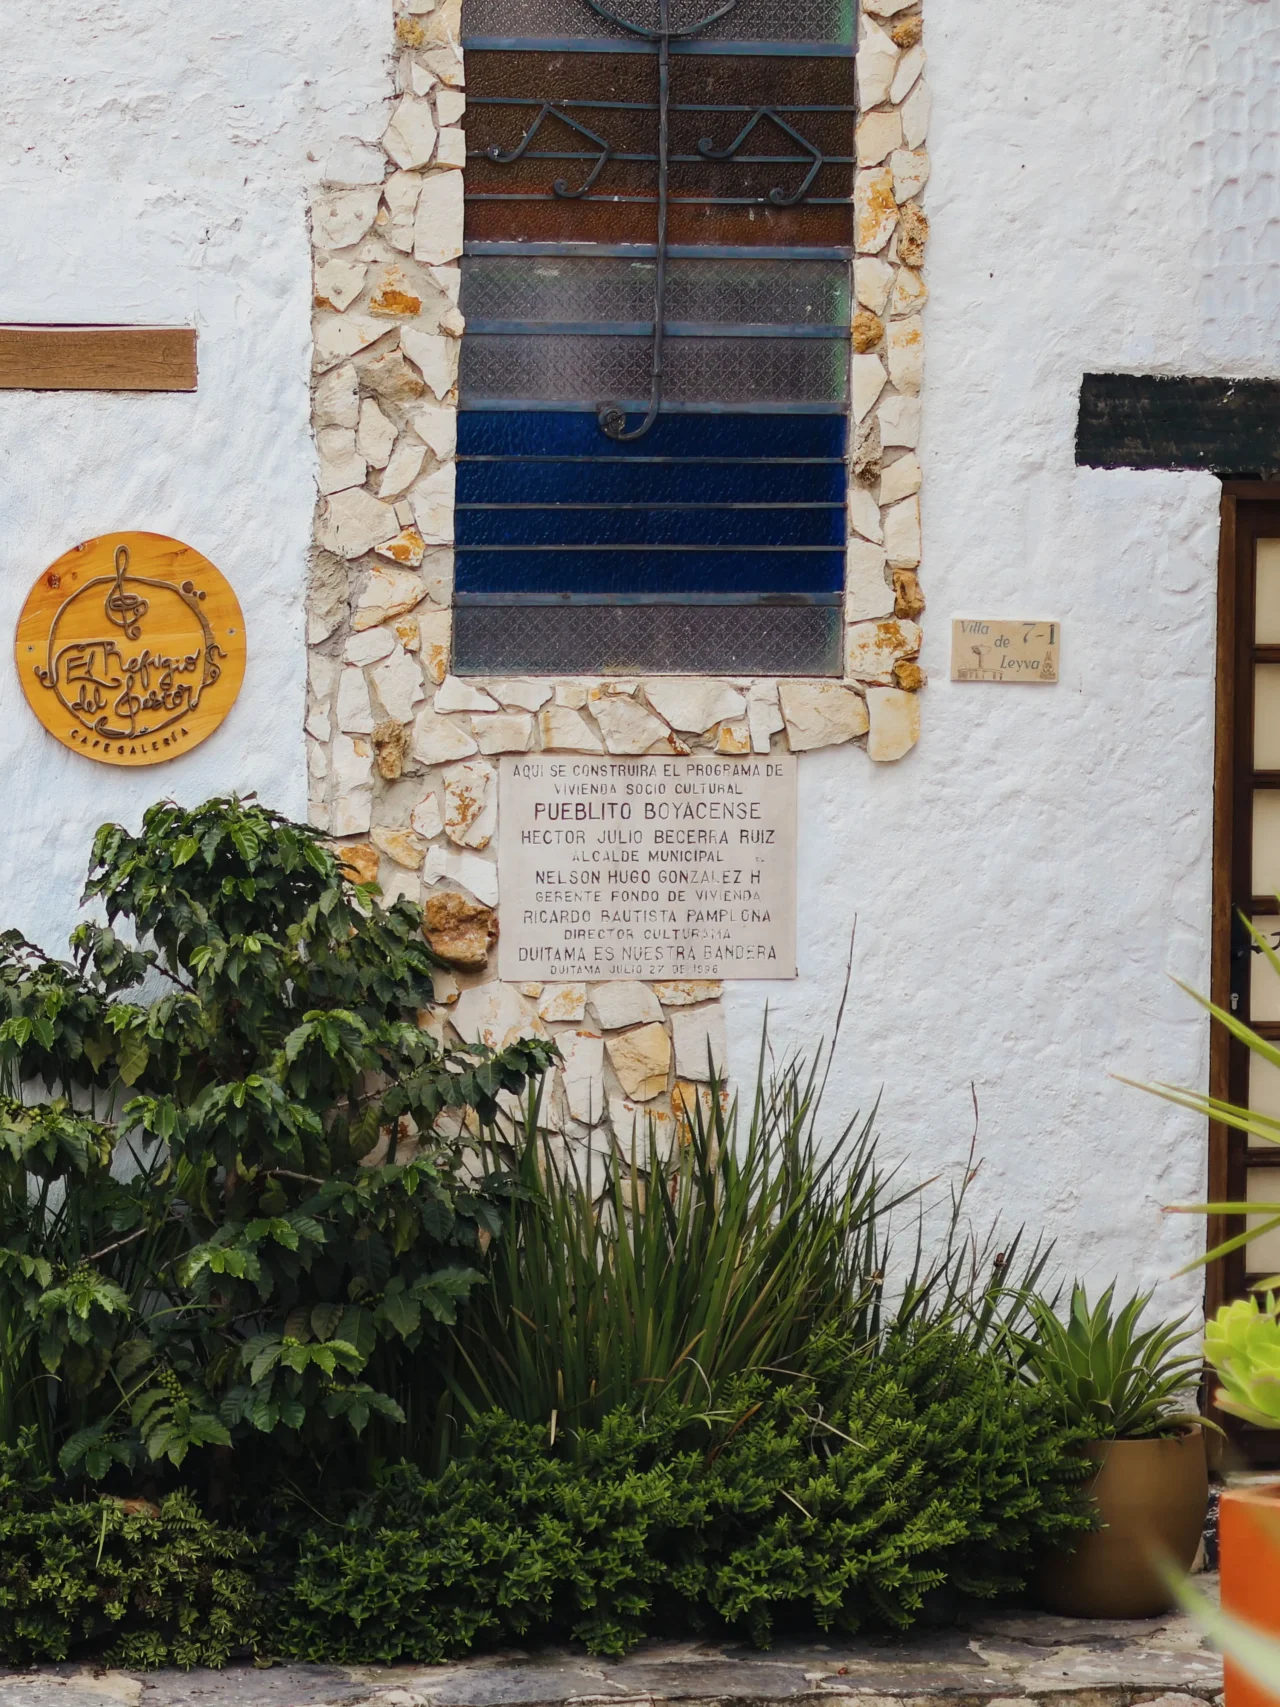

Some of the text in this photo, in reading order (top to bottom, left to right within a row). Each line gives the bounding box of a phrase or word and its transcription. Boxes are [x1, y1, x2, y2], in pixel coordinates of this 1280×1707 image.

[960, 621, 989, 634] Villa
[1022, 623, 1055, 645] 7-1
[994, 635, 1010, 648] de
[1000, 655, 1040, 672] Leyva
[71, 684, 107, 713] del
[513, 764, 783, 779] AQUI SE CONSTRUIRA EL PROGRAMA DE
[553, 783, 743, 795] VIVIENDA SOCIO CULTURAL
[534, 802, 761, 821] PUEBLITO BOYACENSE
[521, 829, 775, 844] HECTOR JULIO BECERRA RUIZ
[572, 850, 724, 862] ALCALDE MUNICIPAL
[536, 870, 761, 885] NELSON HUGO GONZALEZ H
[535, 890, 762, 902] GERENTE FONDO DE VIVIENDA
[523, 909, 771, 924] RICARDO BAUTISTA PAMPLONA
[564, 929, 634, 940] DIRECTOR
[519, 945, 777, 962] DUITAMA ES NUESTRA BANDERA
[550, 964, 718, 975] DUITAMA JULIO 27 DE 1996
